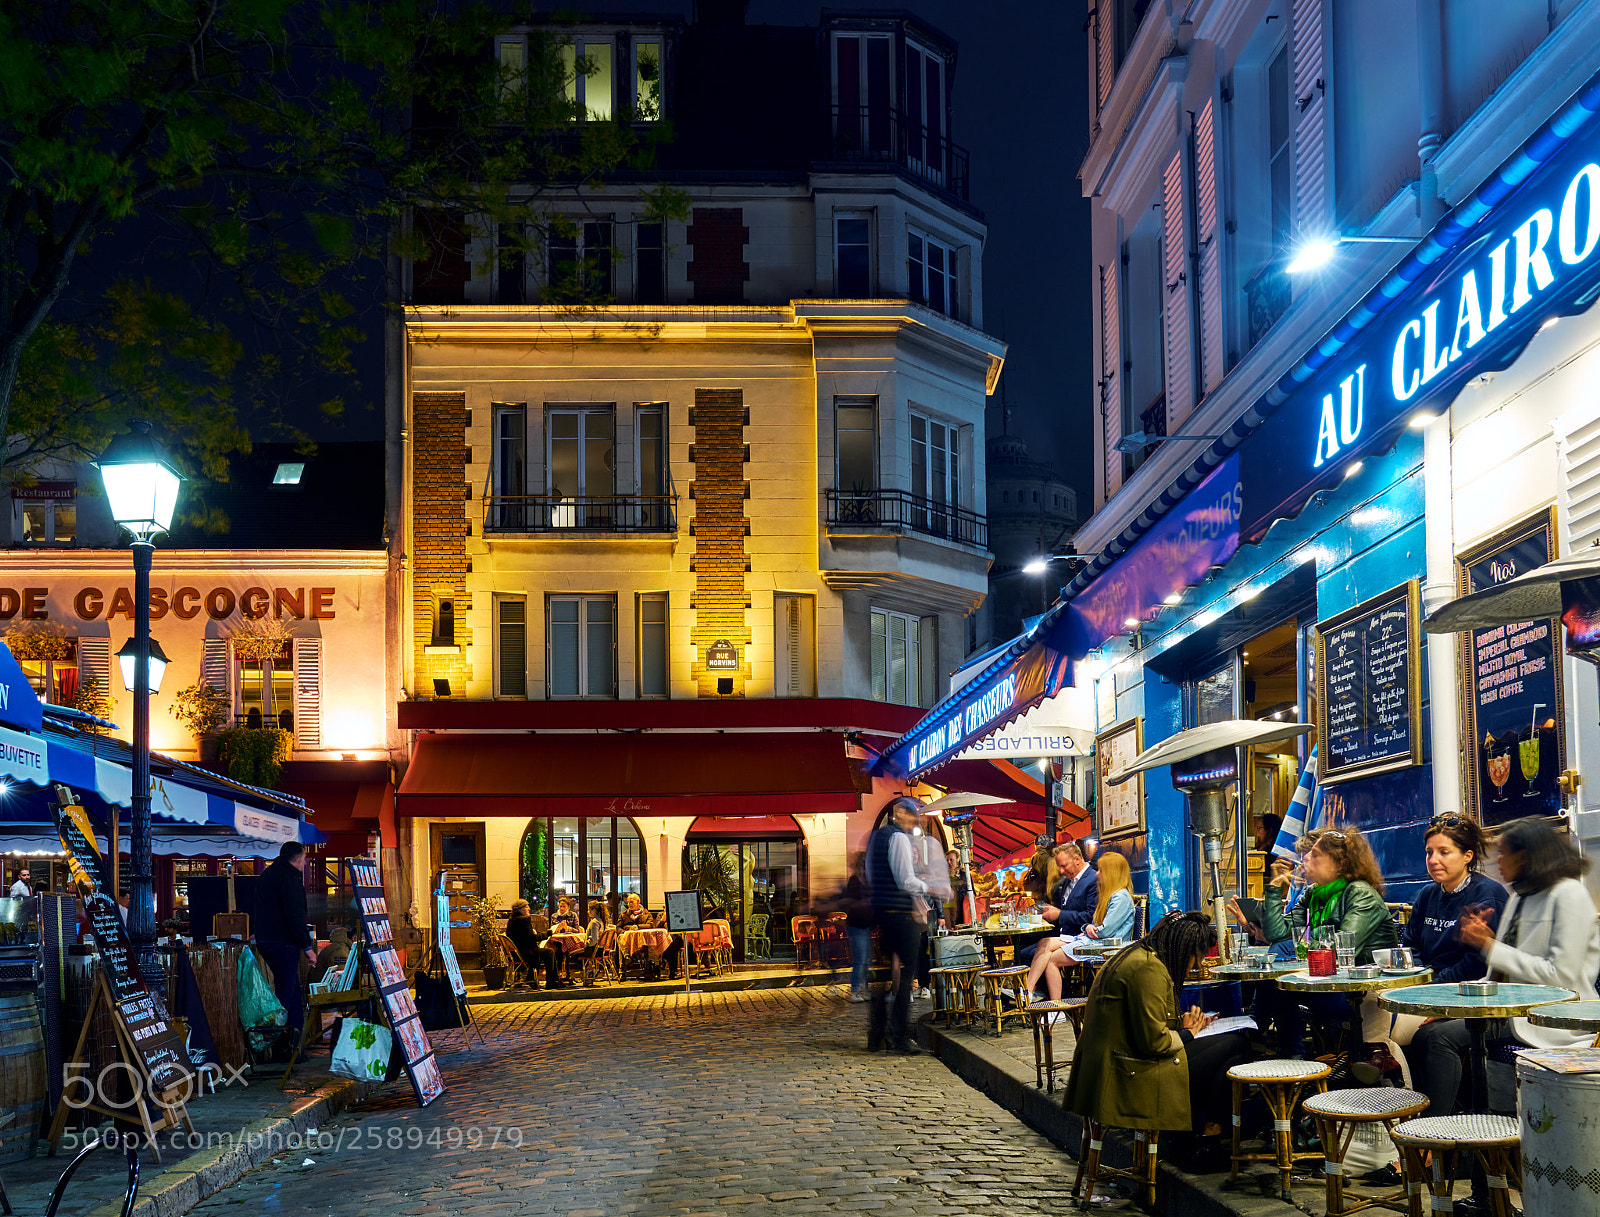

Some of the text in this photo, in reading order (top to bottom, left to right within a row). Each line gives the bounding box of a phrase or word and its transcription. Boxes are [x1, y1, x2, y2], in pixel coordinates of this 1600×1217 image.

[1313, 163, 1600, 467] AU CLAIRO
[16, 488, 71, 497] Restaurant
[1490, 558, 1516, 583] Nos
[0, 587, 336, 620] DE GASCOGNE
[1504, 649, 1527, 667] ROYAL
[1520, 656, 1546, 677] FRAISE
[909, 673, 1016, 772] AU CLAIRON DES CHASSEURS
[974, 735, 1075, 751] GRILLADES
[0, 743, 41, 769] BUVETTE
[1424, 917, 1457, 928] NEW YORK
